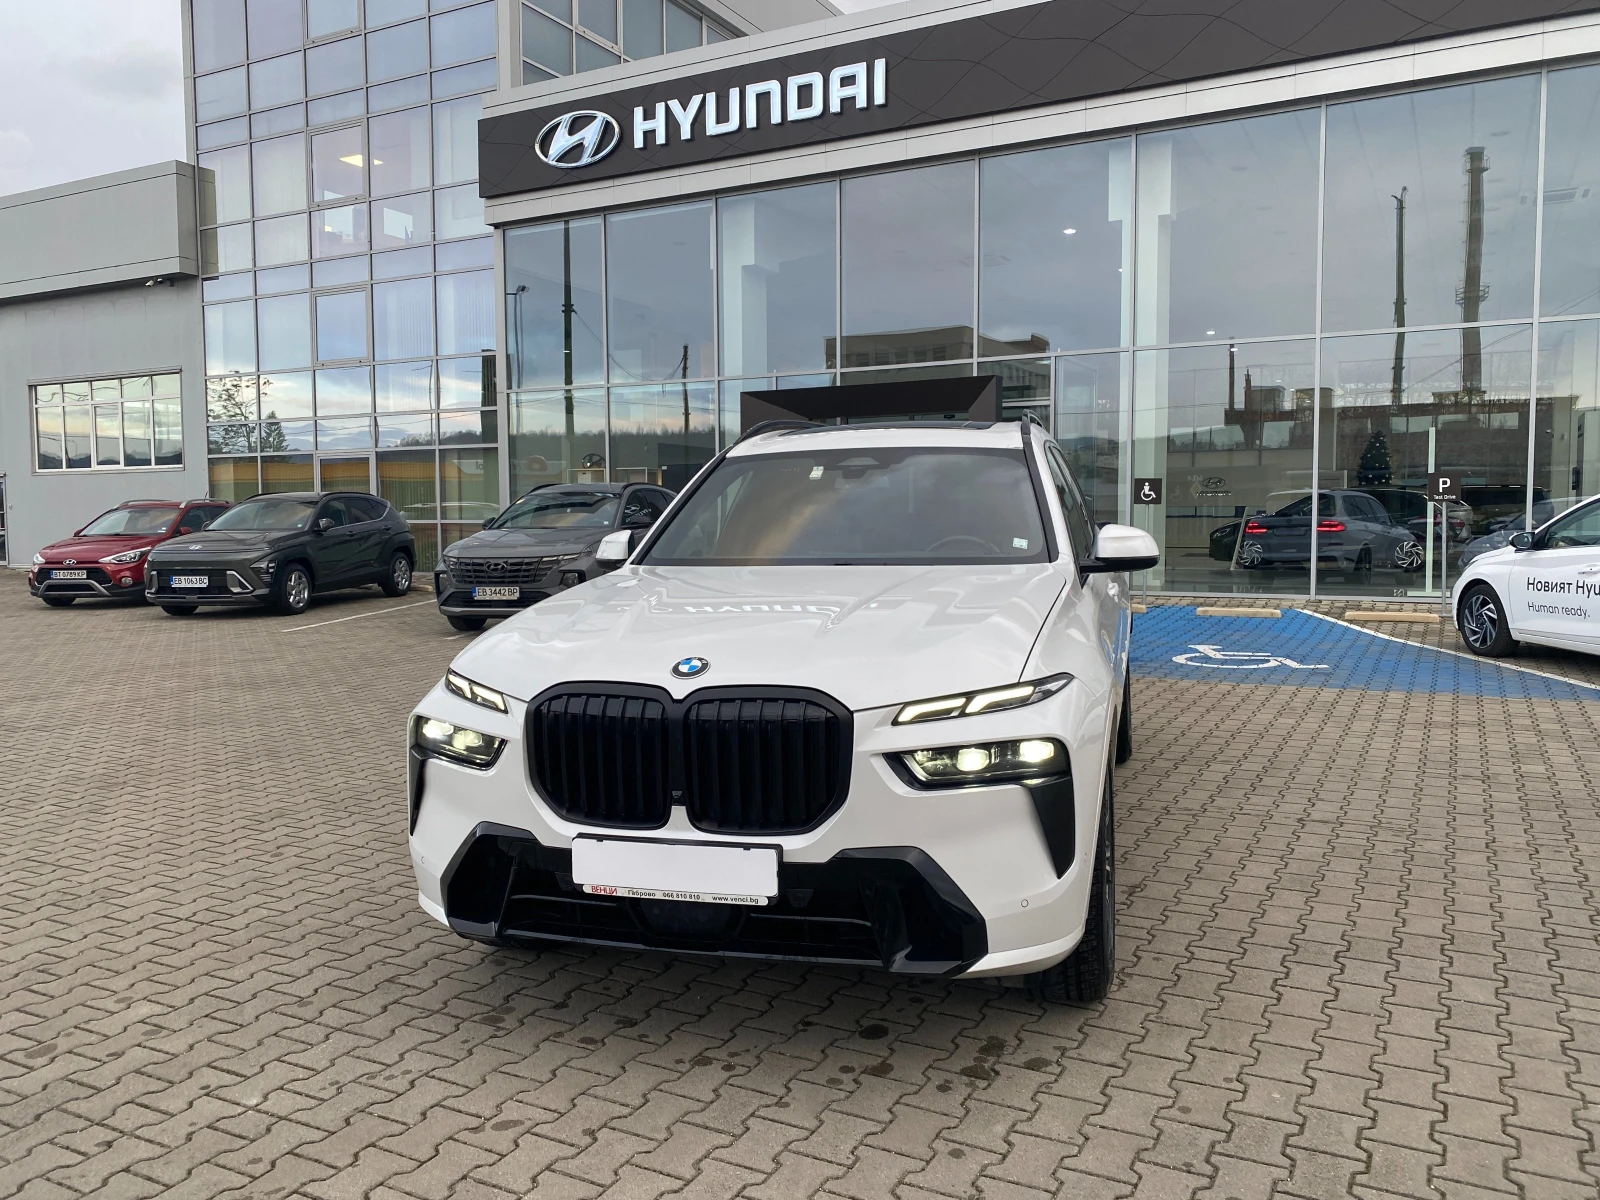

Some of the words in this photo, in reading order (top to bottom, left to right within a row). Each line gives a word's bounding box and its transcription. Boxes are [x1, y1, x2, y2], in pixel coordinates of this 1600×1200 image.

[633, 57, 887, 150] HYUNDAI
[1439, 477, 1451, 493] P
[174, 577, 182, 585] EB
[183, 577, 198, 585] 1063
[198, 577, 207, 585] BC
[1527, 577, 1573, 594] Новият
[477, 588, 487, 597] EB
[488, 588, 507, 597] 3442
[507, 588, 518, 597] BP
[1527, 601, 1560, 614] Human
[1561, 605, 1591, 620] ready.
[590, 885, 618, 896] ВЕНЦИ
[627, 890, 656, 899] Габрово
[675, 892, 688, 900] 810
[689, 893, 701, 901] 810
[711, 895, 760, 905] www.venci.bg
